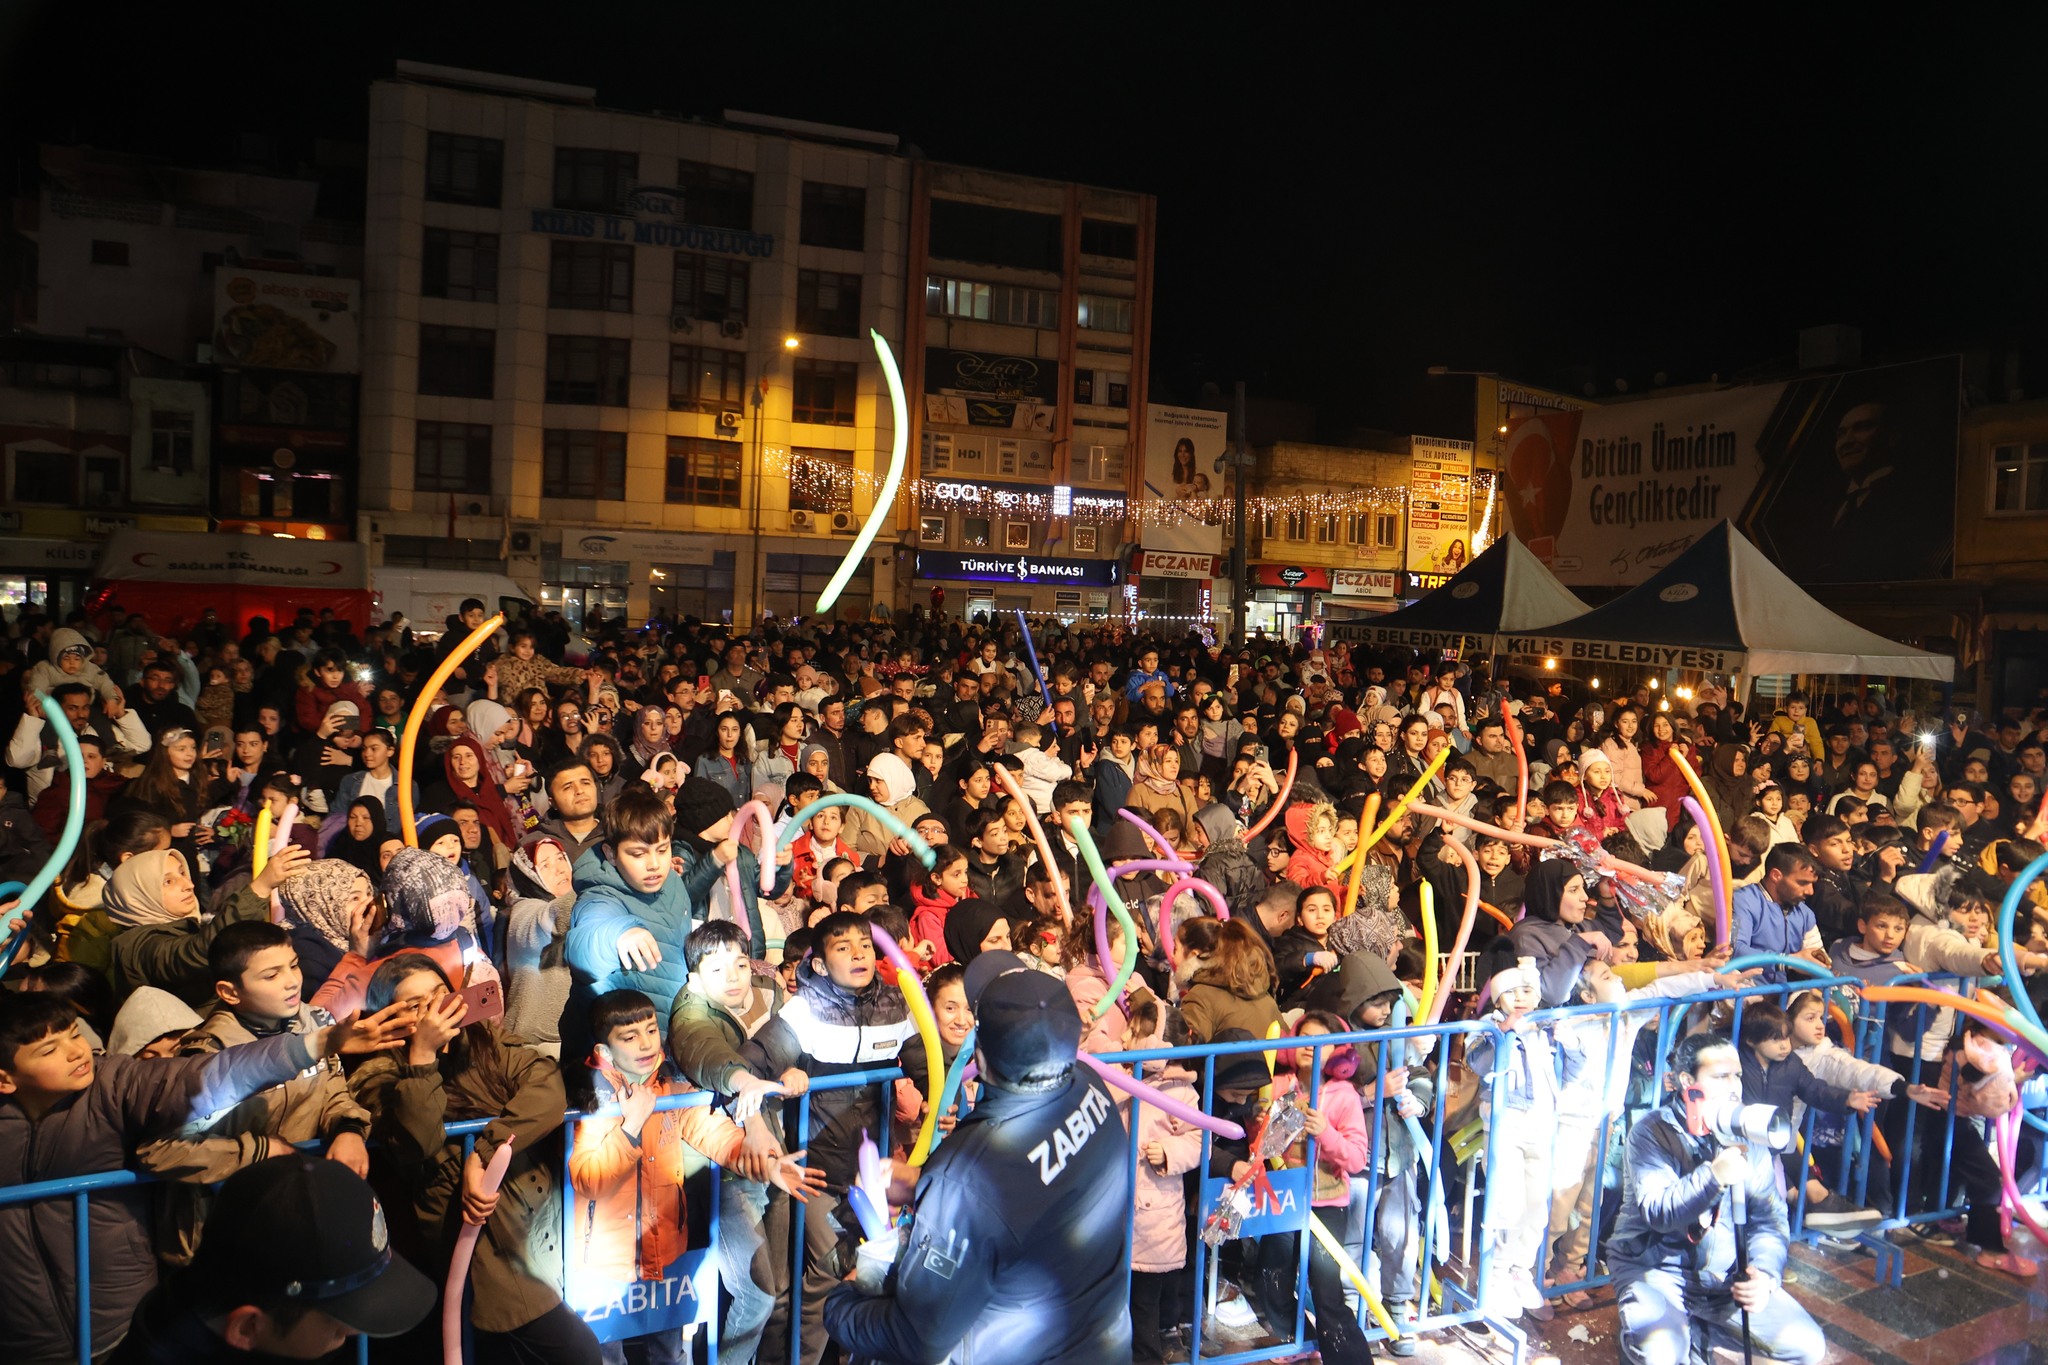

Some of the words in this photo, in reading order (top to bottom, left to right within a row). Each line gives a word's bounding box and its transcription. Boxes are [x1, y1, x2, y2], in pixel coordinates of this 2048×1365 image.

[958, 449, 981, 459] HDI
[1422, 450, 1432, 459] TEK
[1581, 436, 1641, 479] Bütün
[1652, 422, 1736, 472] Ümidim
[993, 489, 1040, 508] sigota
[1590, 475, 1721, 529] Gençliktedir
[46, 547, 87, 560] KİLİS
[583, 542, 607, 552] SGK
[168, 561, 224, 571] SAĞLIK
[228, 562, 309, 575] BAKANLIĞI
[961, 558, 1015, 573] TÜRKİYE
[1030, 565, 1084, 576] BANKASI
[1145, 555, 1210, 572] ECZANE
[1336, 572, 1392, 588] ECZANE
[1420, 575, 1452, 589] TRE
[1027, 1083, 1111, 1186] ZABITA
